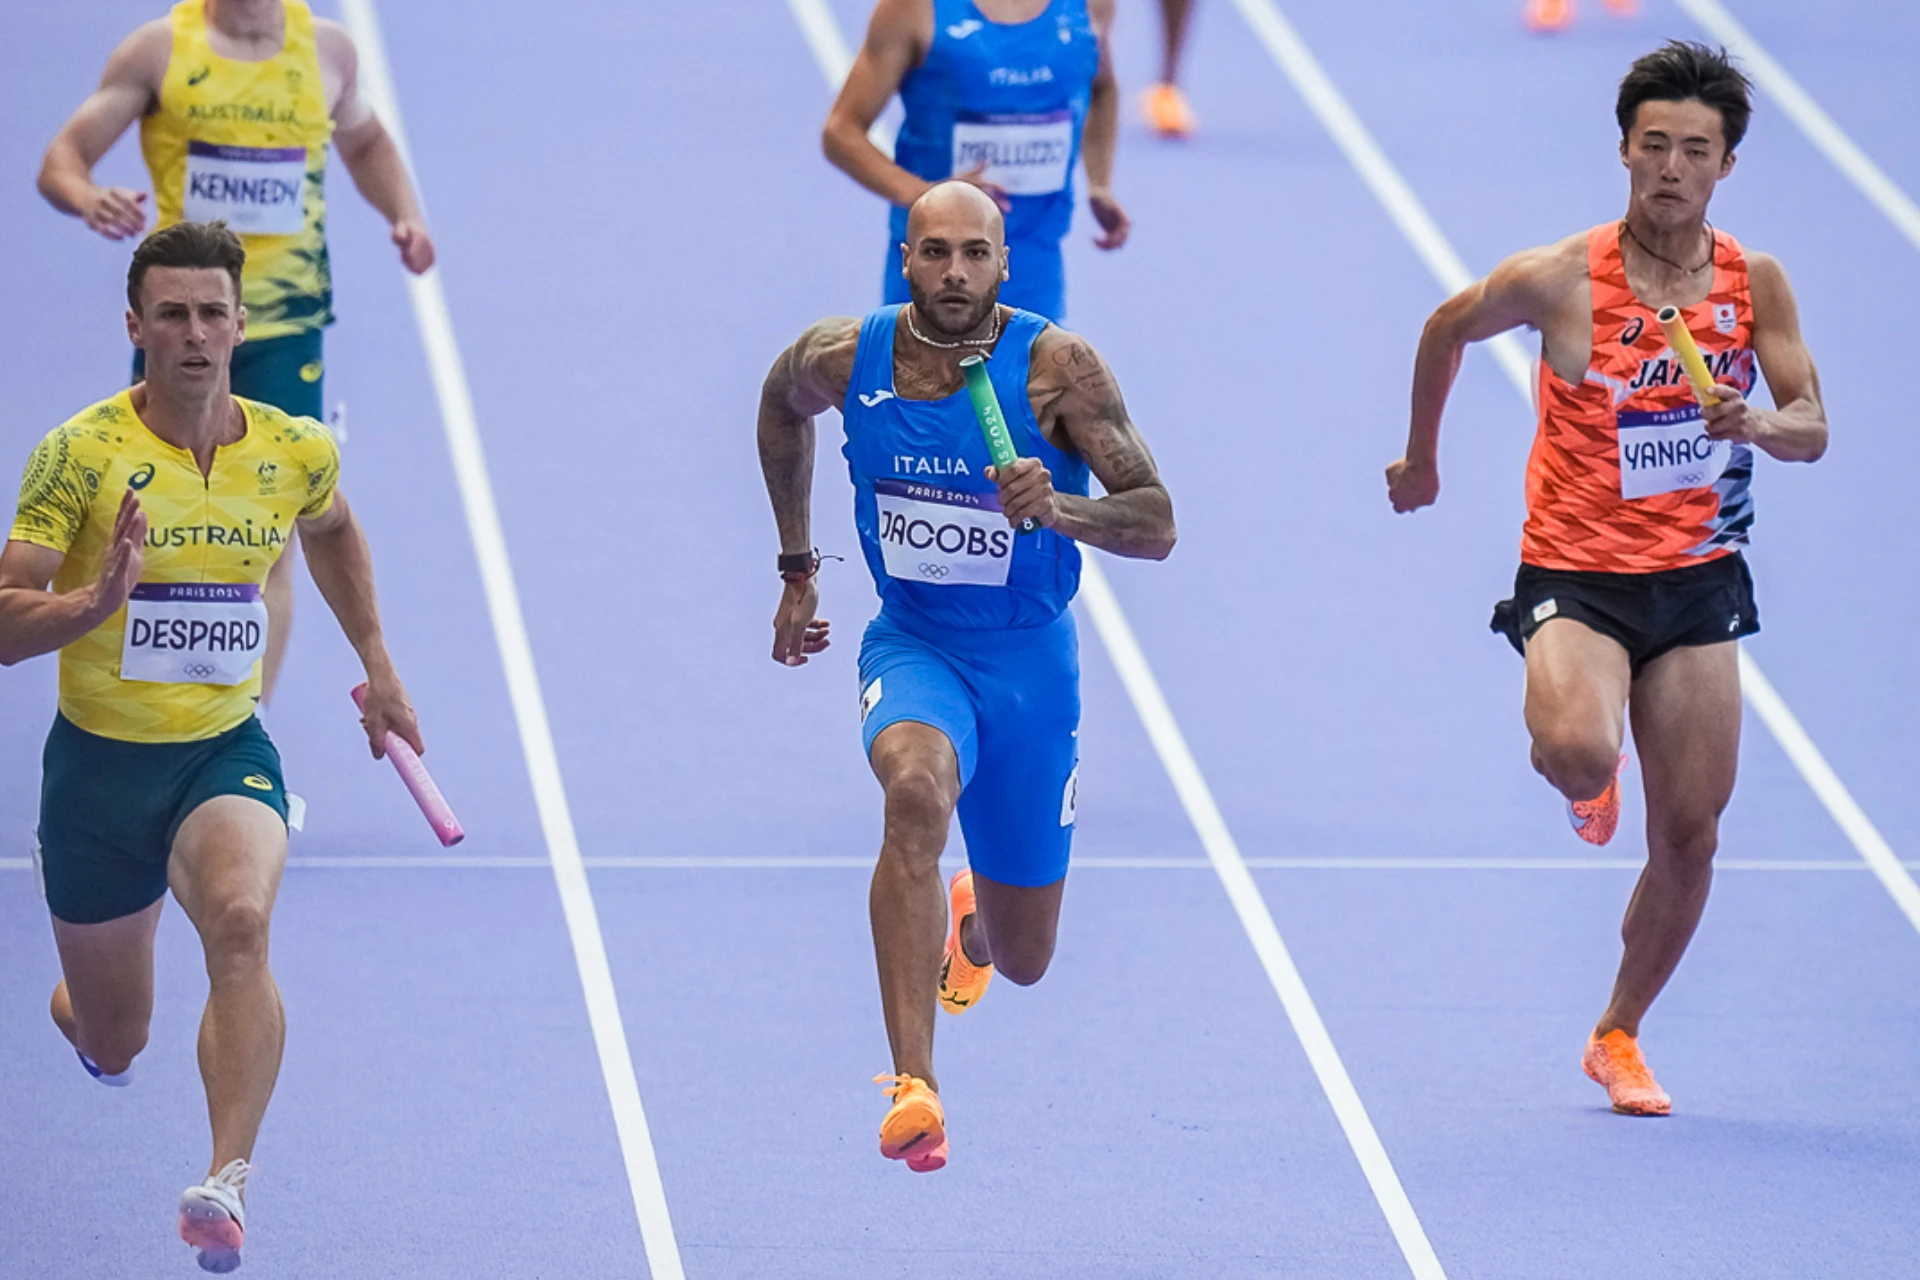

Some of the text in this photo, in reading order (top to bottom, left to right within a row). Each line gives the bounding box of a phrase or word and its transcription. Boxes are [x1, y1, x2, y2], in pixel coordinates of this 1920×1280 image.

[988, 66, 1054, 86] ITALIA
[187, 102, 298, 123] AUSTRALIA
[190, 171, 299, 205] KENNEDY
[1653, 409, 1687, 423] PARIS
[893, 455, 970, 476] ITALIA
[907, 485, 980, 505] PARIS 2024
[881, 510, 1010, 558] JACOBS
[1022, 517, 1034, 531] 8
[144, 525, 279, 547] USTRALIA
[169, 586, 242, 599] PARIS 2024
[130, 618, 261, 652] DESPARD
